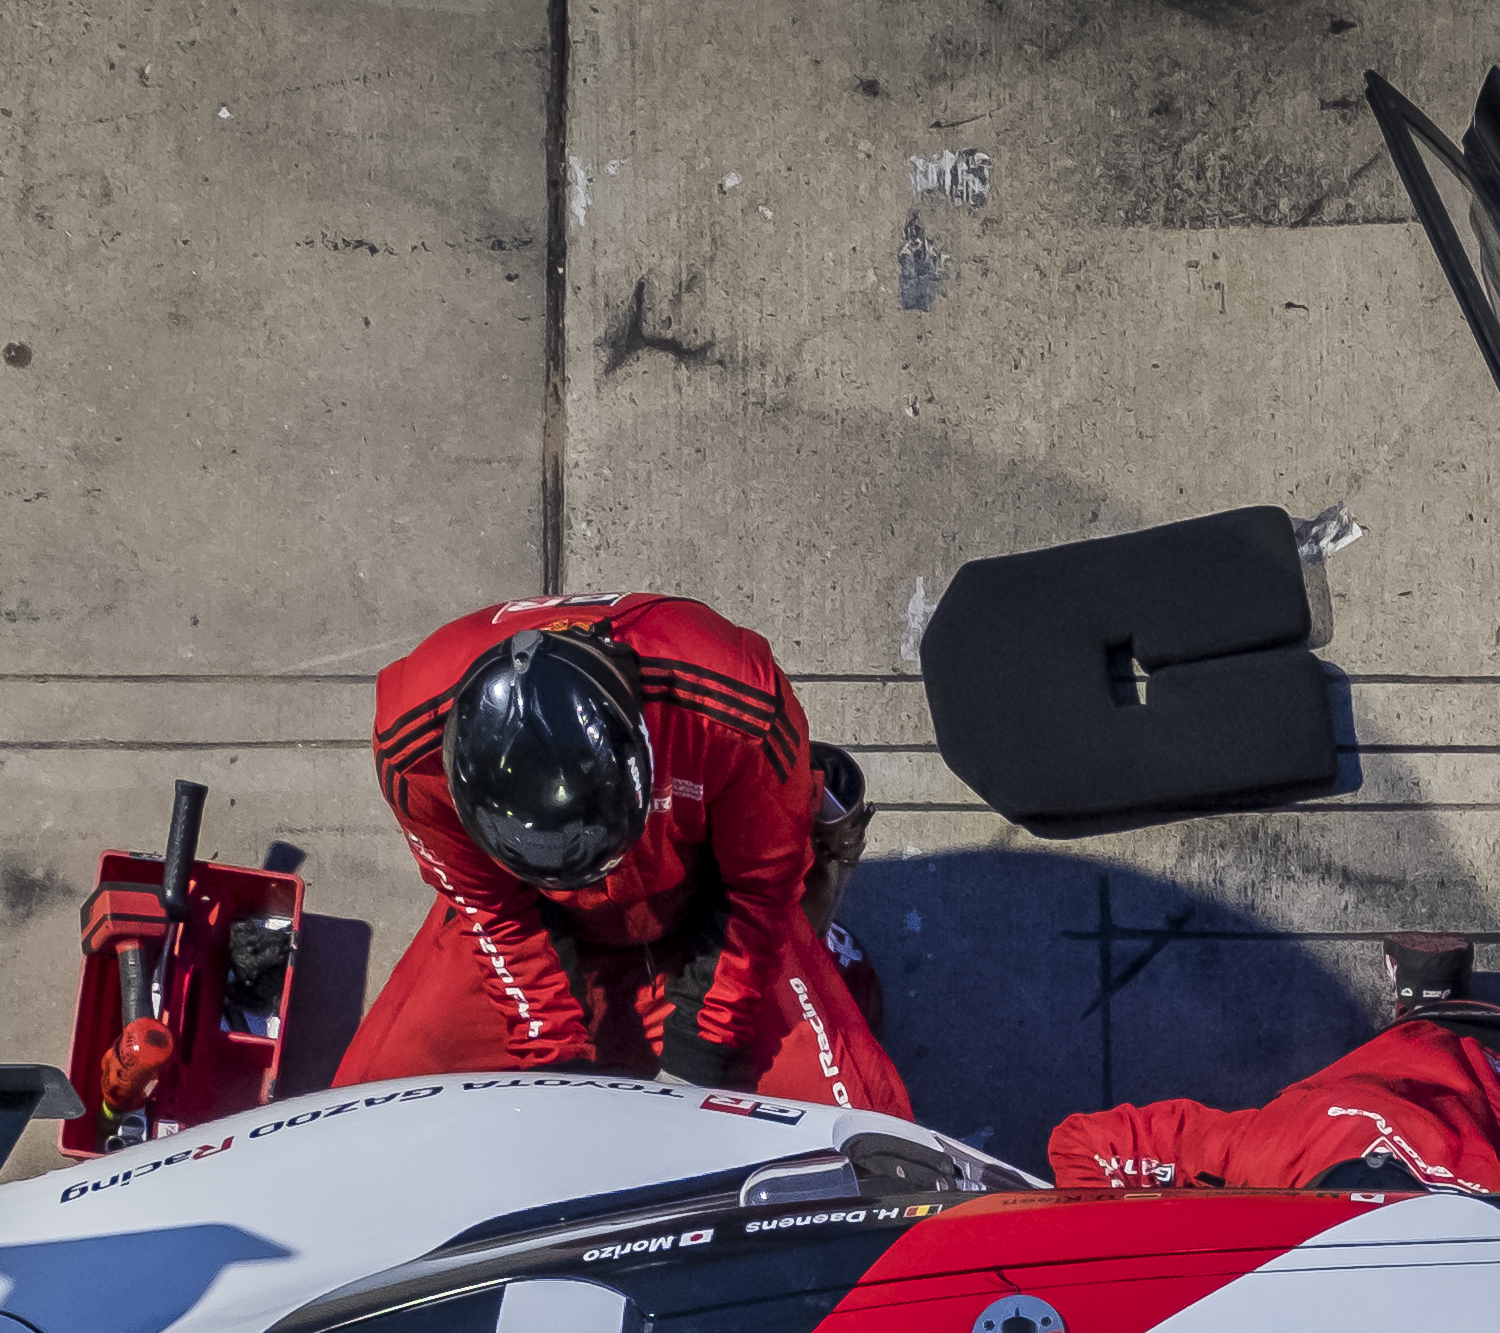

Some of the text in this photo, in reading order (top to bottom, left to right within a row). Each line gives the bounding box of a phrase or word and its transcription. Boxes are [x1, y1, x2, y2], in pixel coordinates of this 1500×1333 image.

[707, 1095, 804, 1124] GR
[60, 1079, 685, 1205] TOYOTA GAZOO Racing
[745, 1206, 902, 1235] H. Daenens
[582, 1234, 675, 1264] Morizo
